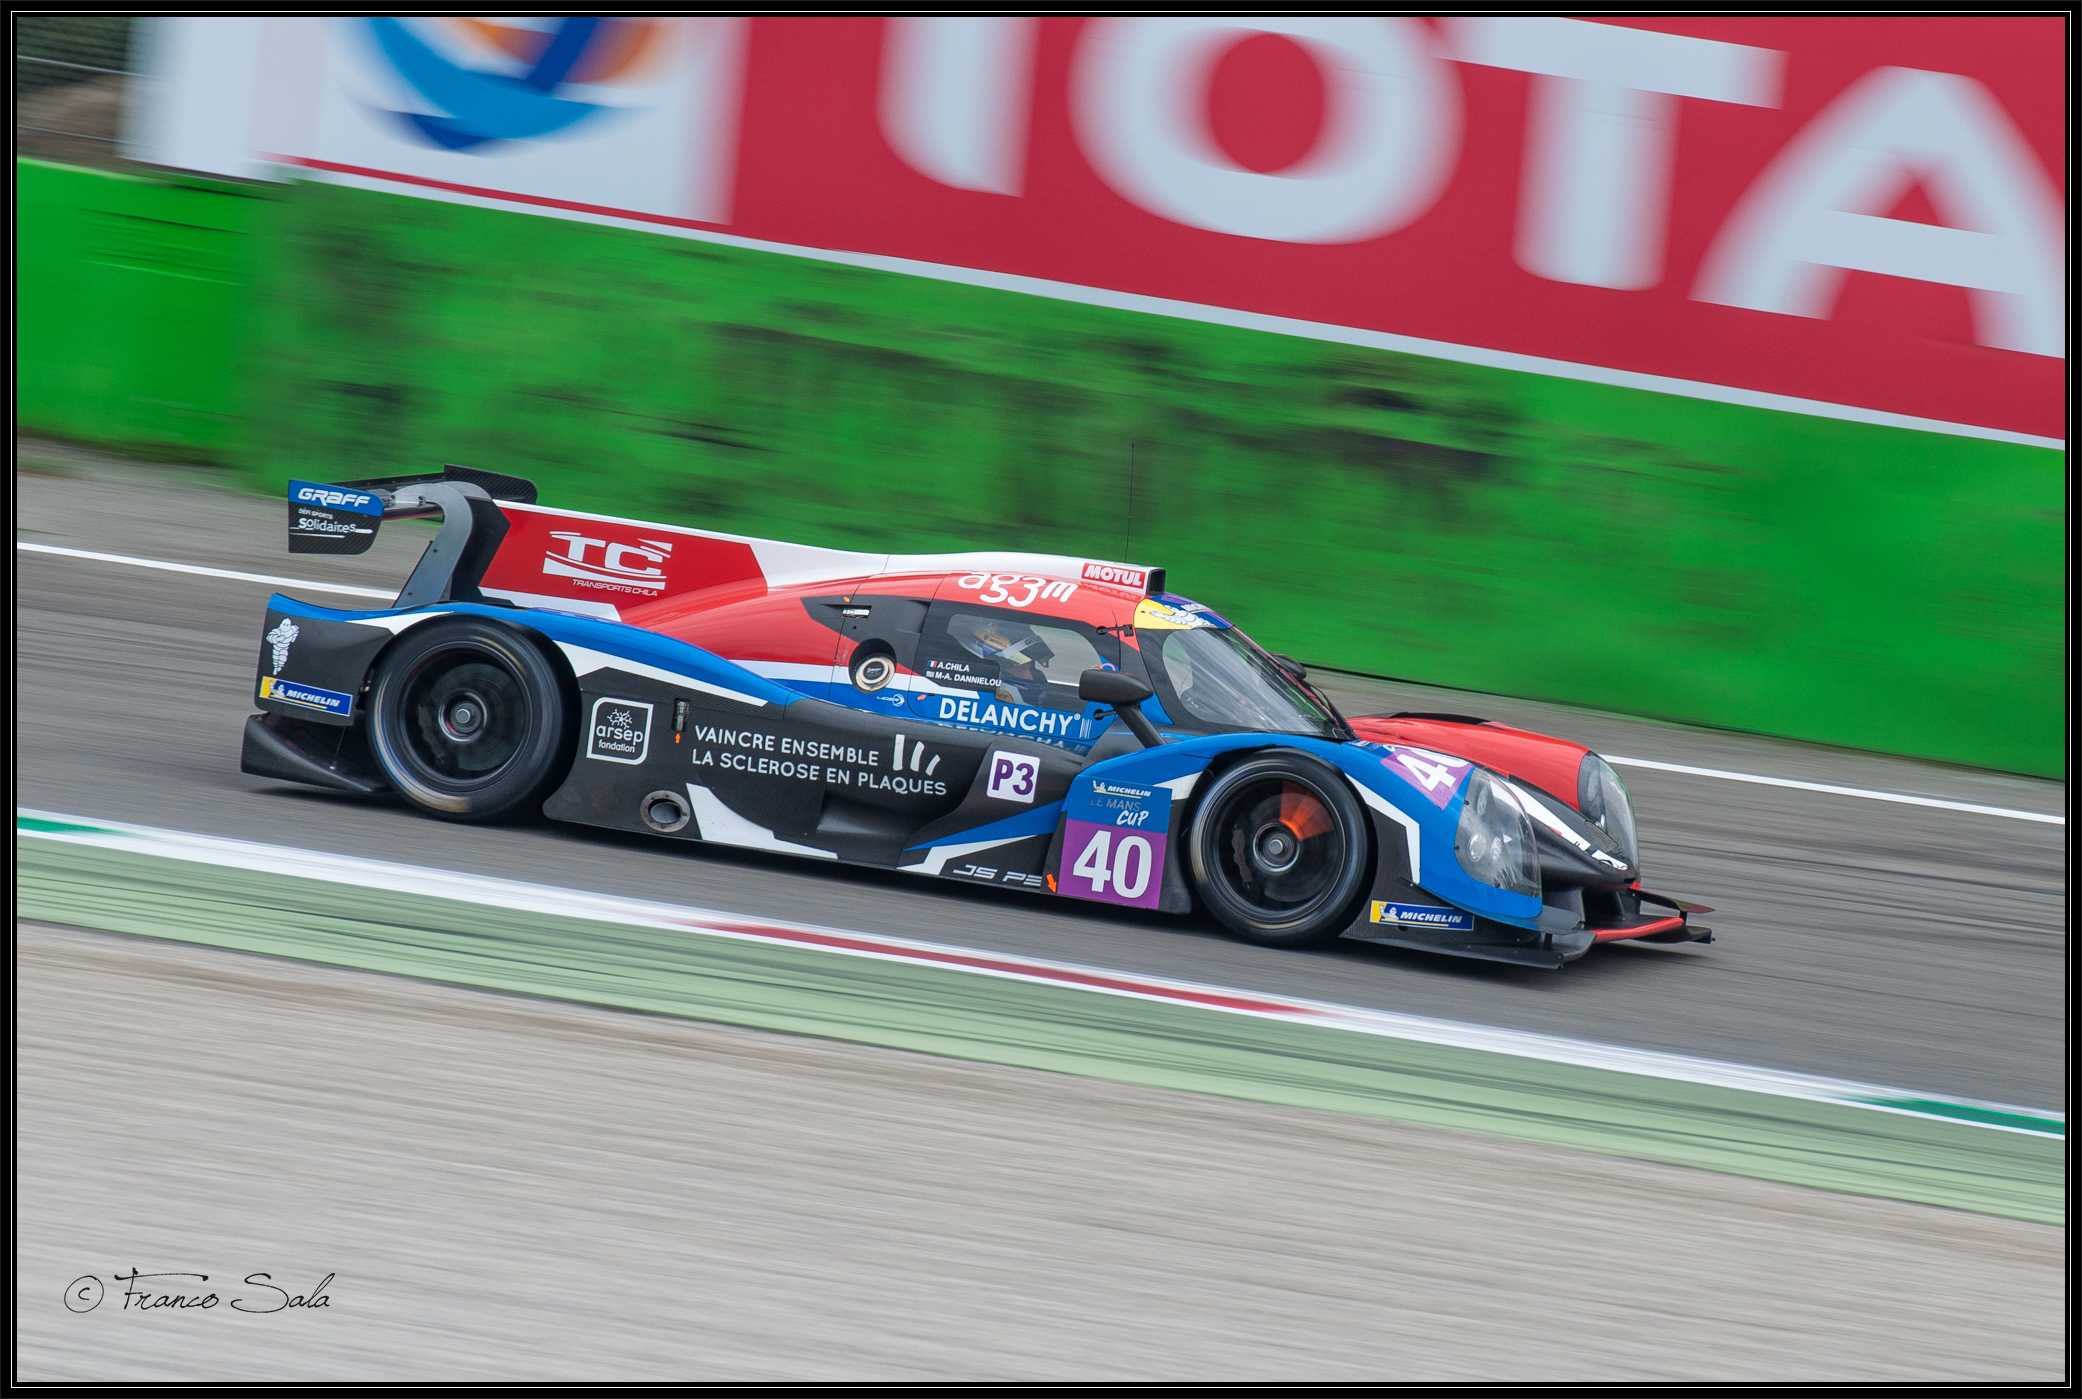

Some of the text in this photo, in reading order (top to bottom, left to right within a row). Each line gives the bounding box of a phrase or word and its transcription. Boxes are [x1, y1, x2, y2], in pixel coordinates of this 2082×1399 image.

[298, 518, 358, 533] Solidaires
[549, 531, 664, 576] TC
[1084, 564, 1142, 587] MOTUL
[572, 579, 658, 597] TRANSPORTS CHILA
[953, 673, 1002, 687] DANNIELOU
[286, 689, 341, 707] MICHELIN
[596, 725, 644, 746] arsep
[598, 739, 636, 753] fondation
[695, 725, 879, 766] VAINCRE ENSEMBLE
[692, 748, 947, 795] LA SCLEROSE EN PLAQUES
[992, 758, 1035, 796] P3
[1107, 785, 1152, 797] MICHELIN
[1090, 796, 1142, 812] LE MANS
[1116, 810, 1150, 826] CUP
[952, 864, 998, 879] JS
[1072, 829, 1153, 898] 40
[1400, 911, 1463, 923] MICHELIN
